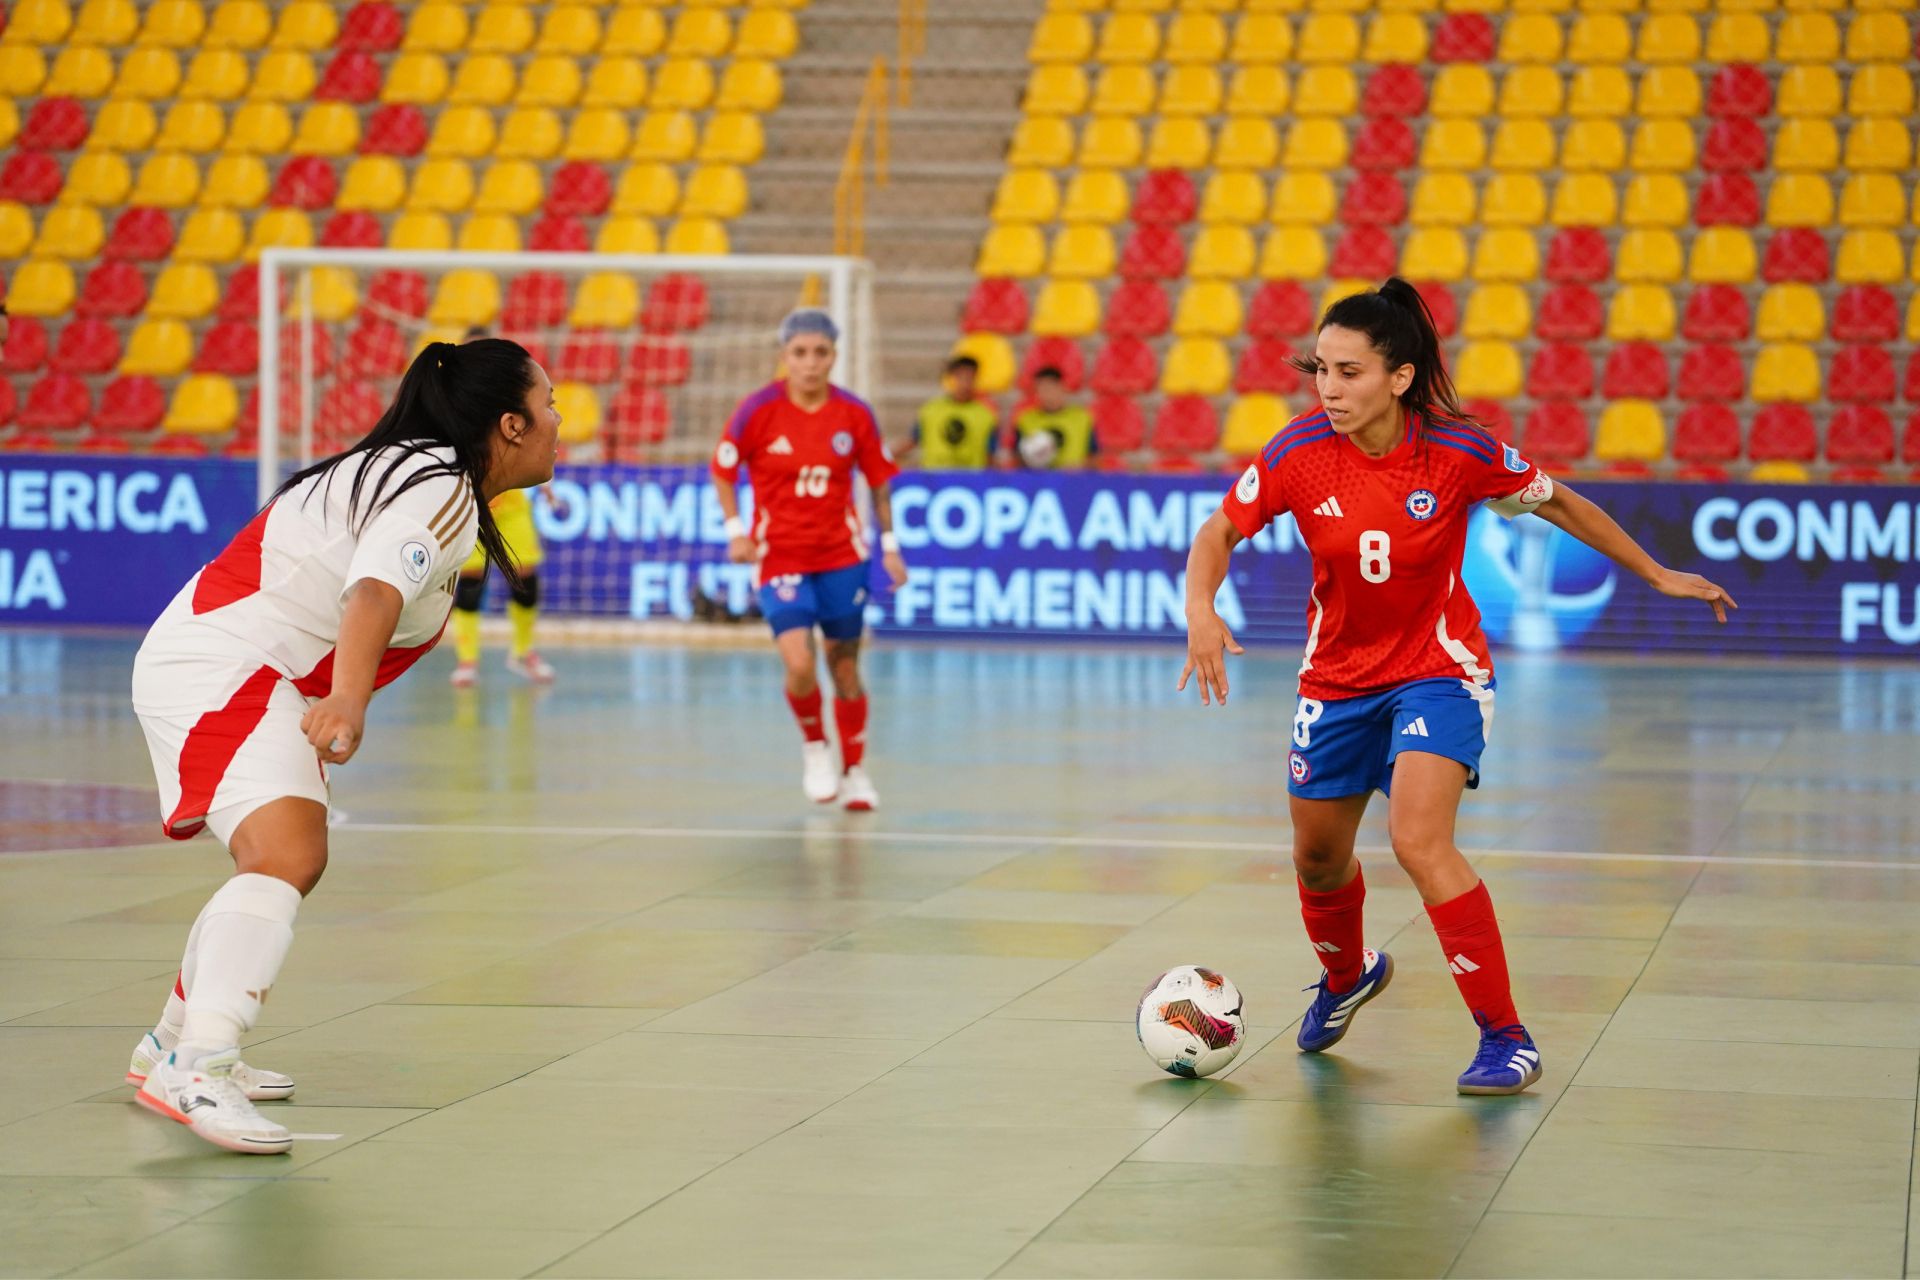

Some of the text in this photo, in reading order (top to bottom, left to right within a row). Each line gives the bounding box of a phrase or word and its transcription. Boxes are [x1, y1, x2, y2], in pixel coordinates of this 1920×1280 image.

[0, 470, 208, 534] ERICA
[795, 465, 831, 497] 10
[890, 486, 1072, 550] COPA
[1692, 497, 1920, 562] CONM
[0, 549, 68, 611] A
[1359, 530, 1391, 584] 8
[1294, 697, 1323, 748] 8
